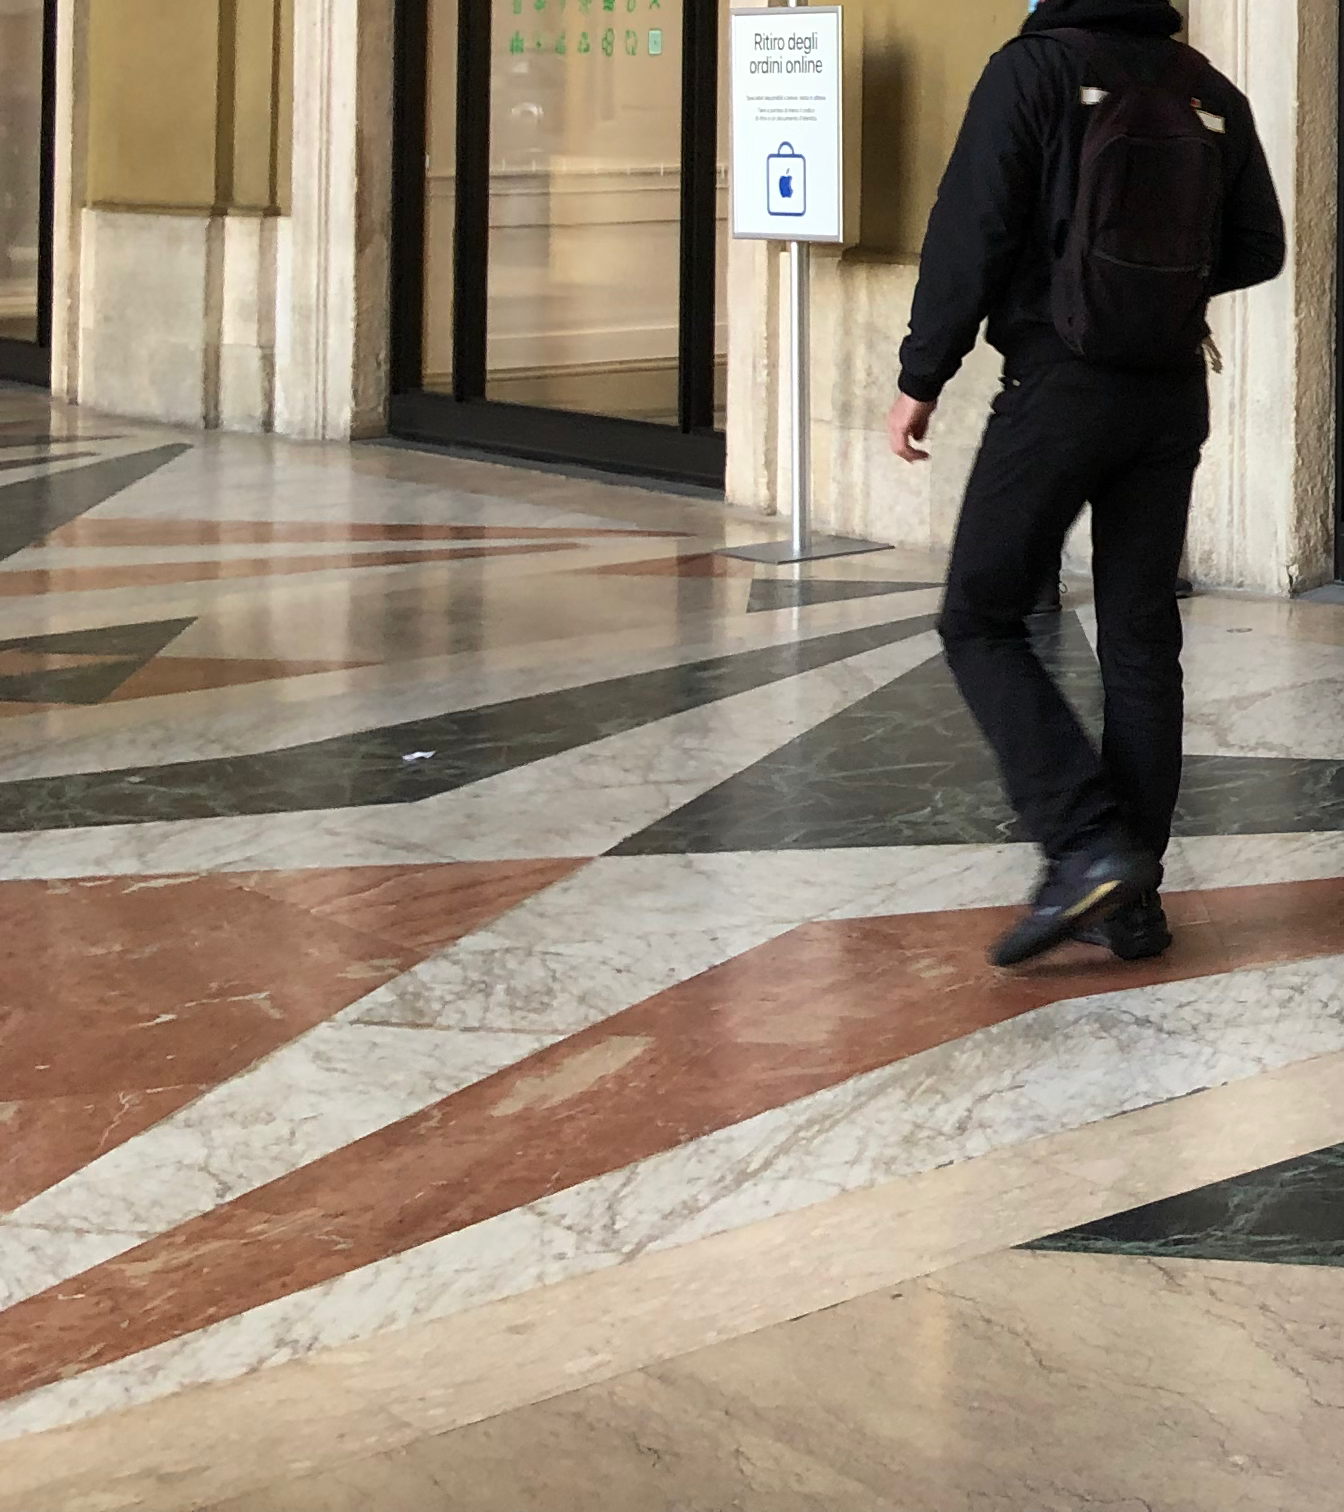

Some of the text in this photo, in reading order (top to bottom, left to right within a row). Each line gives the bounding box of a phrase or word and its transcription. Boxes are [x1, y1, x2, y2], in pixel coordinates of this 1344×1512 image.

[754, 32, 818, 54] Ritiro degli
[749, 55, 823, 74] ordini online
